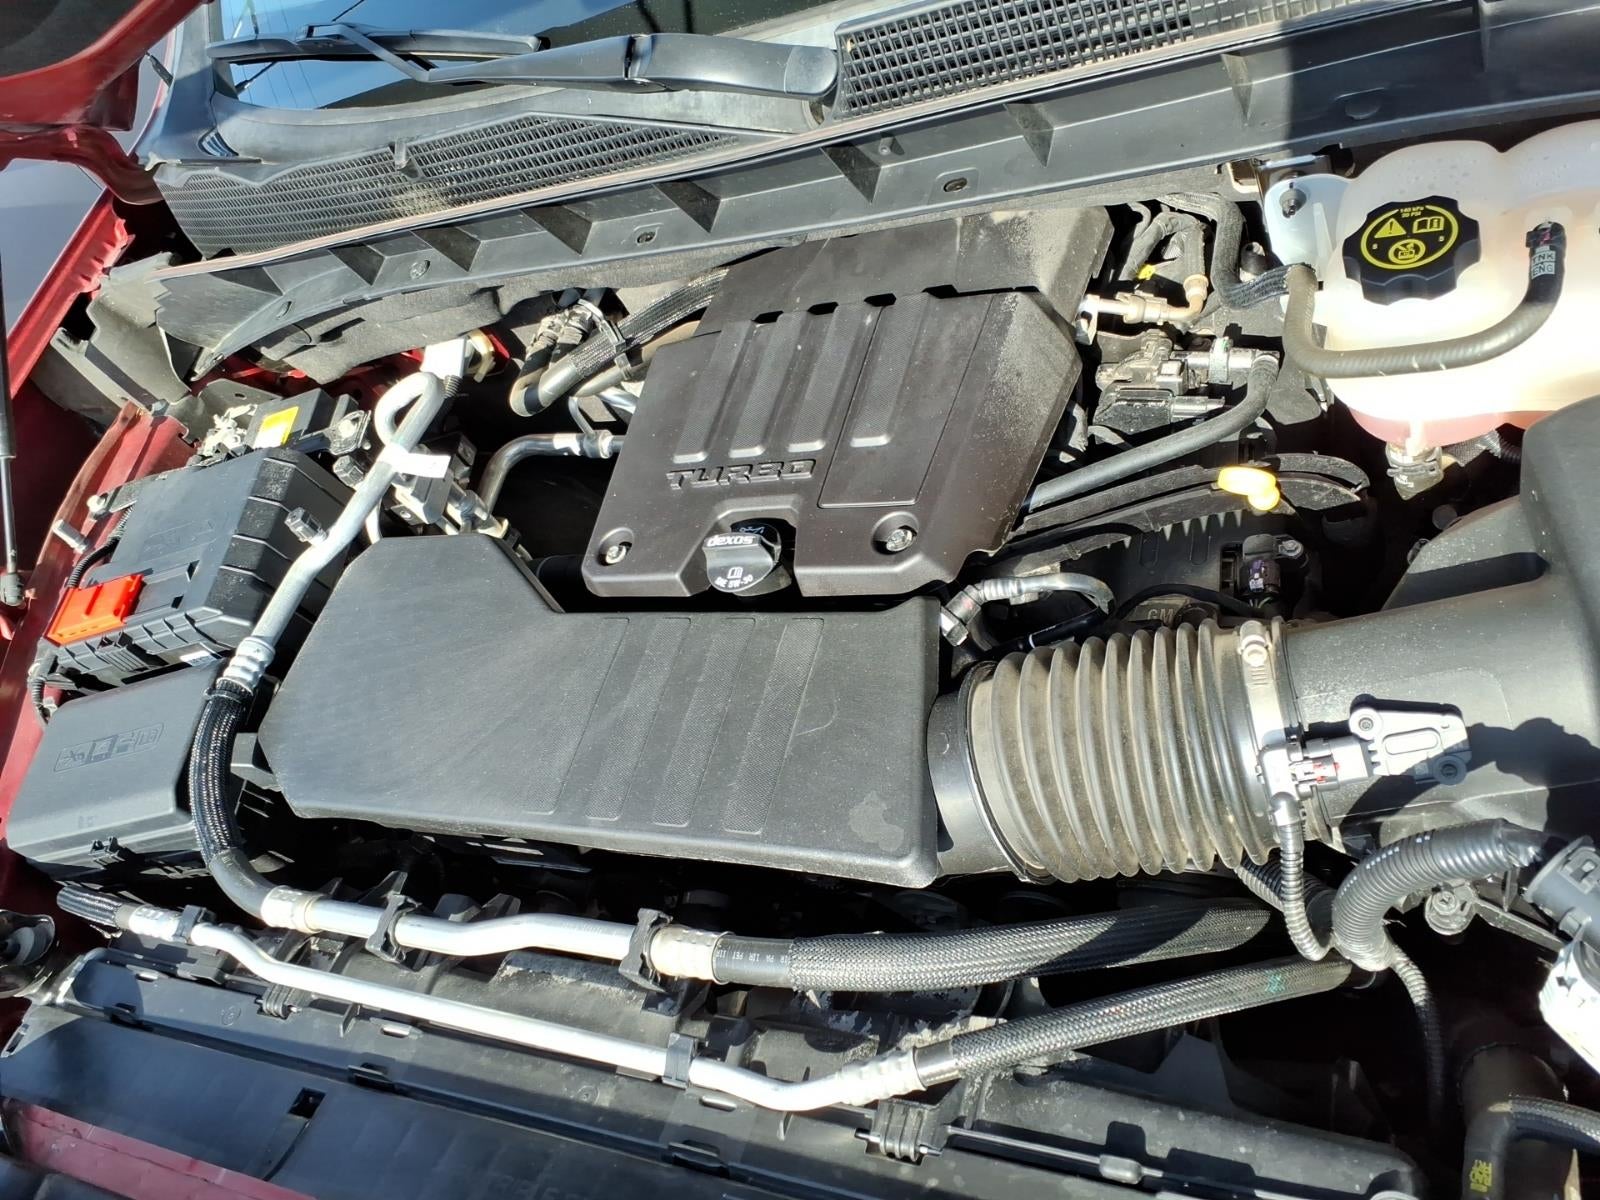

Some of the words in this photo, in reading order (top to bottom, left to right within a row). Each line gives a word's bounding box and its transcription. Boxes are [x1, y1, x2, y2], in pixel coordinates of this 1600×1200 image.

[1532, 264, 1553, 276] ENG
[665, 458, 816, 490] TURBO
[707, 535, 755, 547] dexos
